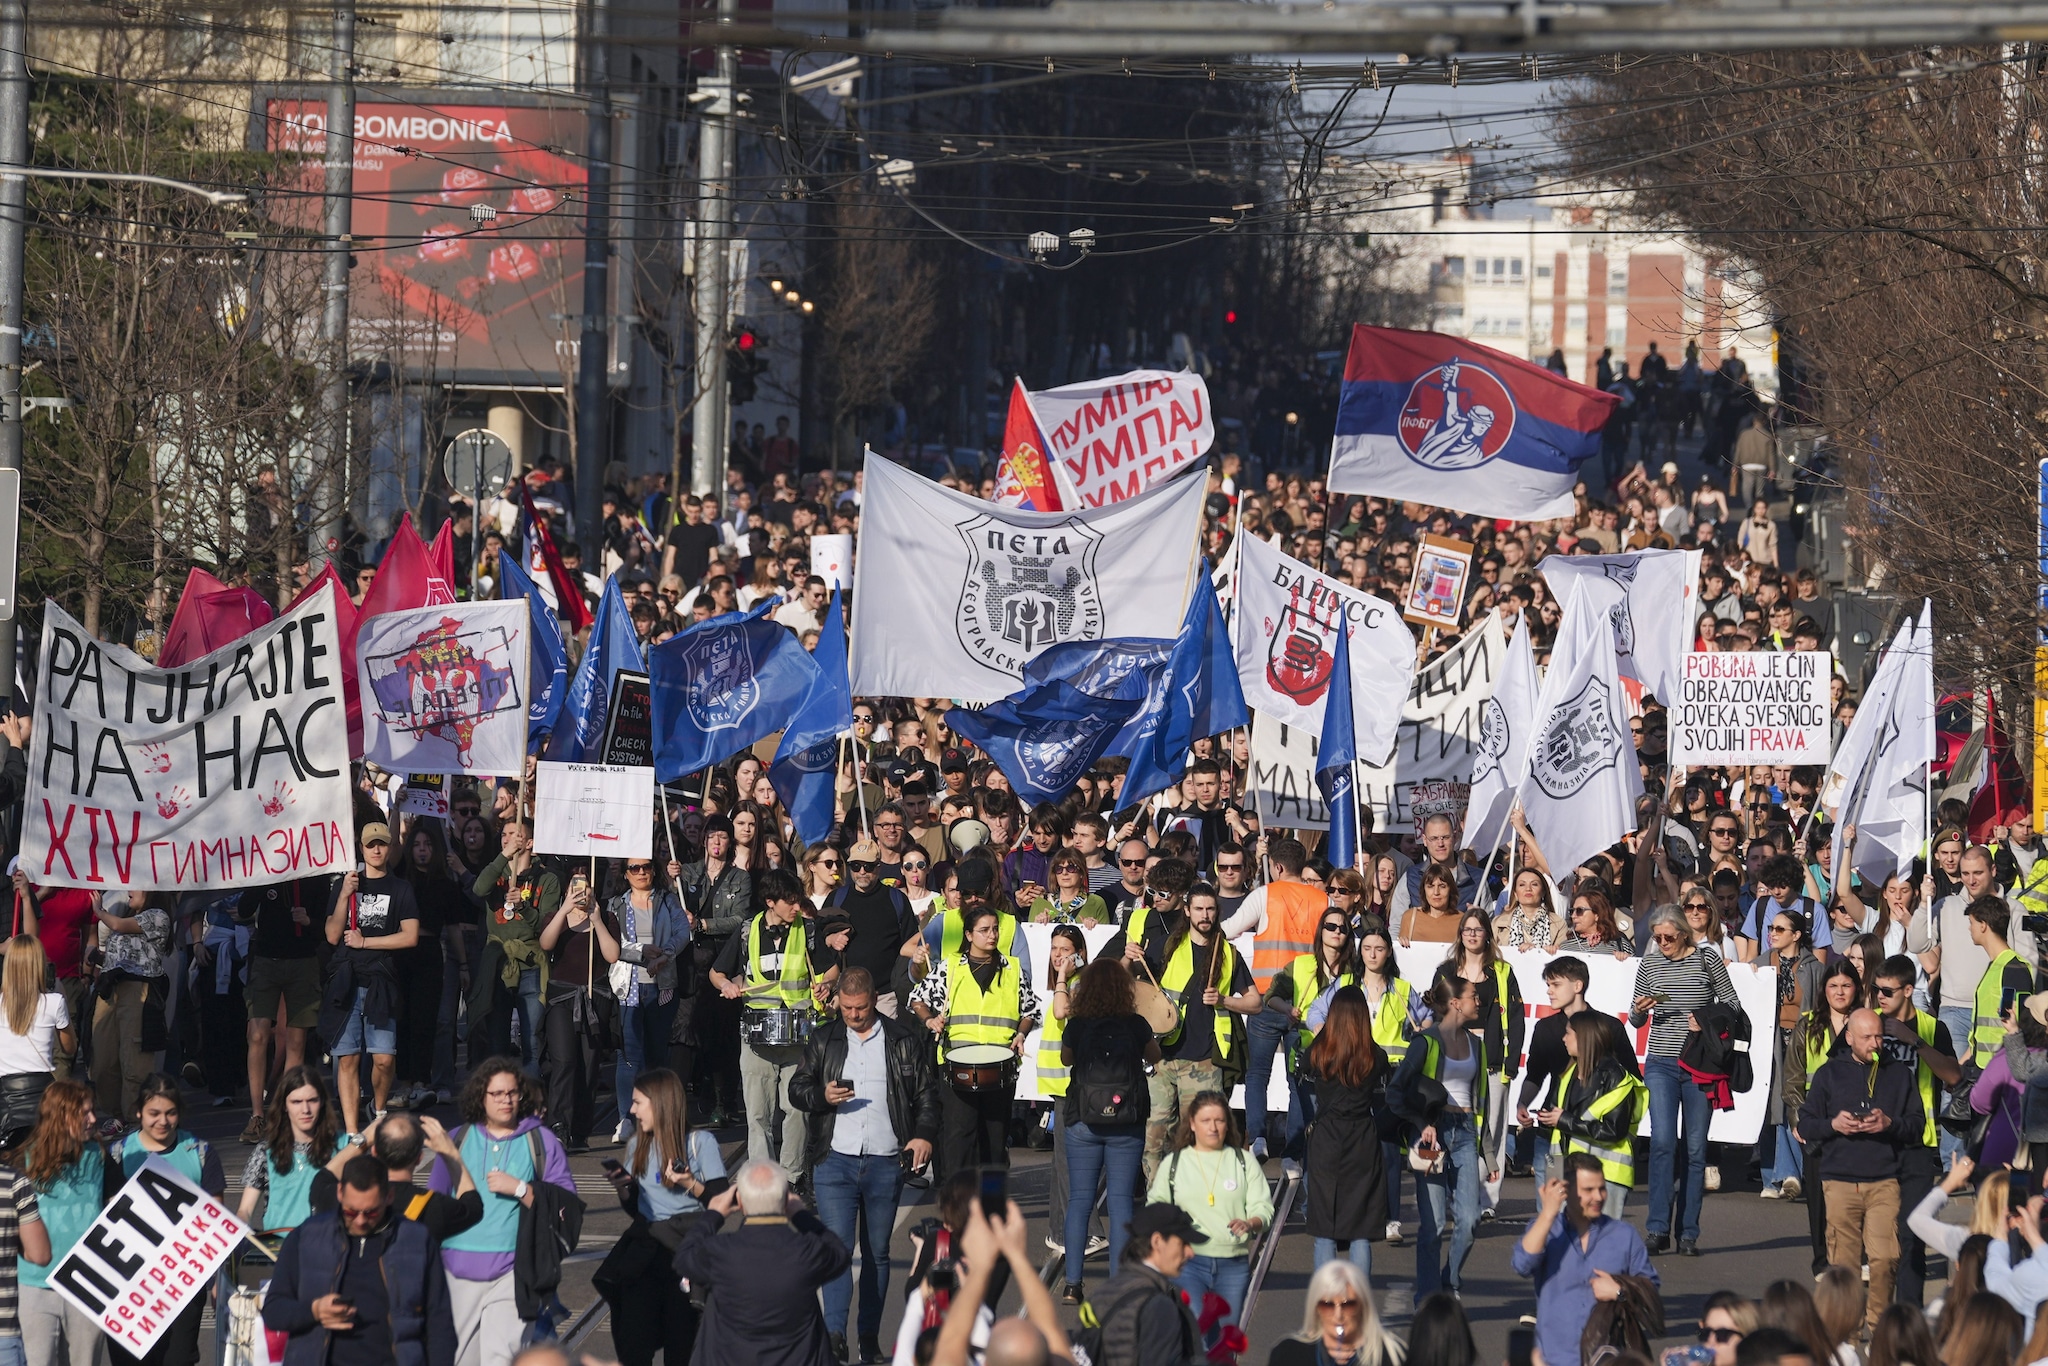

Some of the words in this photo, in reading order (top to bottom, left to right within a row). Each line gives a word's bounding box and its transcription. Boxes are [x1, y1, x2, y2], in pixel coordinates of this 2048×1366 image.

[1401, 416, 1435, 430] ПФБГ
[1065, 387, 1204, 487] УМПАЈ
[987, 529, 1071, 556] ПЕТА
[1271, 562, 1385, 630] БАПУСС
[1429, 603, 1439, 613] 15
[700, 630, 739, 660] ПЕТА
[1762, 655, 1782, 678] JE
[1786, 652, 1816, 678] ČIN
[1684, 679, 1812, 703] OBRAZOVANOG
[1744, 703, 1823, 727] SVESNOG
[43, 712, 144, 802] НА
[194, 696, 340, 799] НАС
[614, 735, 646, 751] CHECK
[1684, 728, 1745, 751] SVOJIH
[1541, 766, 1590, 791] ГИМНАЗИЈА
[42, 798, 141, 885] XIV
[150, 820, 348, 885] ГИМНАЗИЈА
[53, 1168, 199, 1316] ПЕТА
[104, 1202, 222, 1335] београдска
[127, 1218, 240, 1347] гимназија
